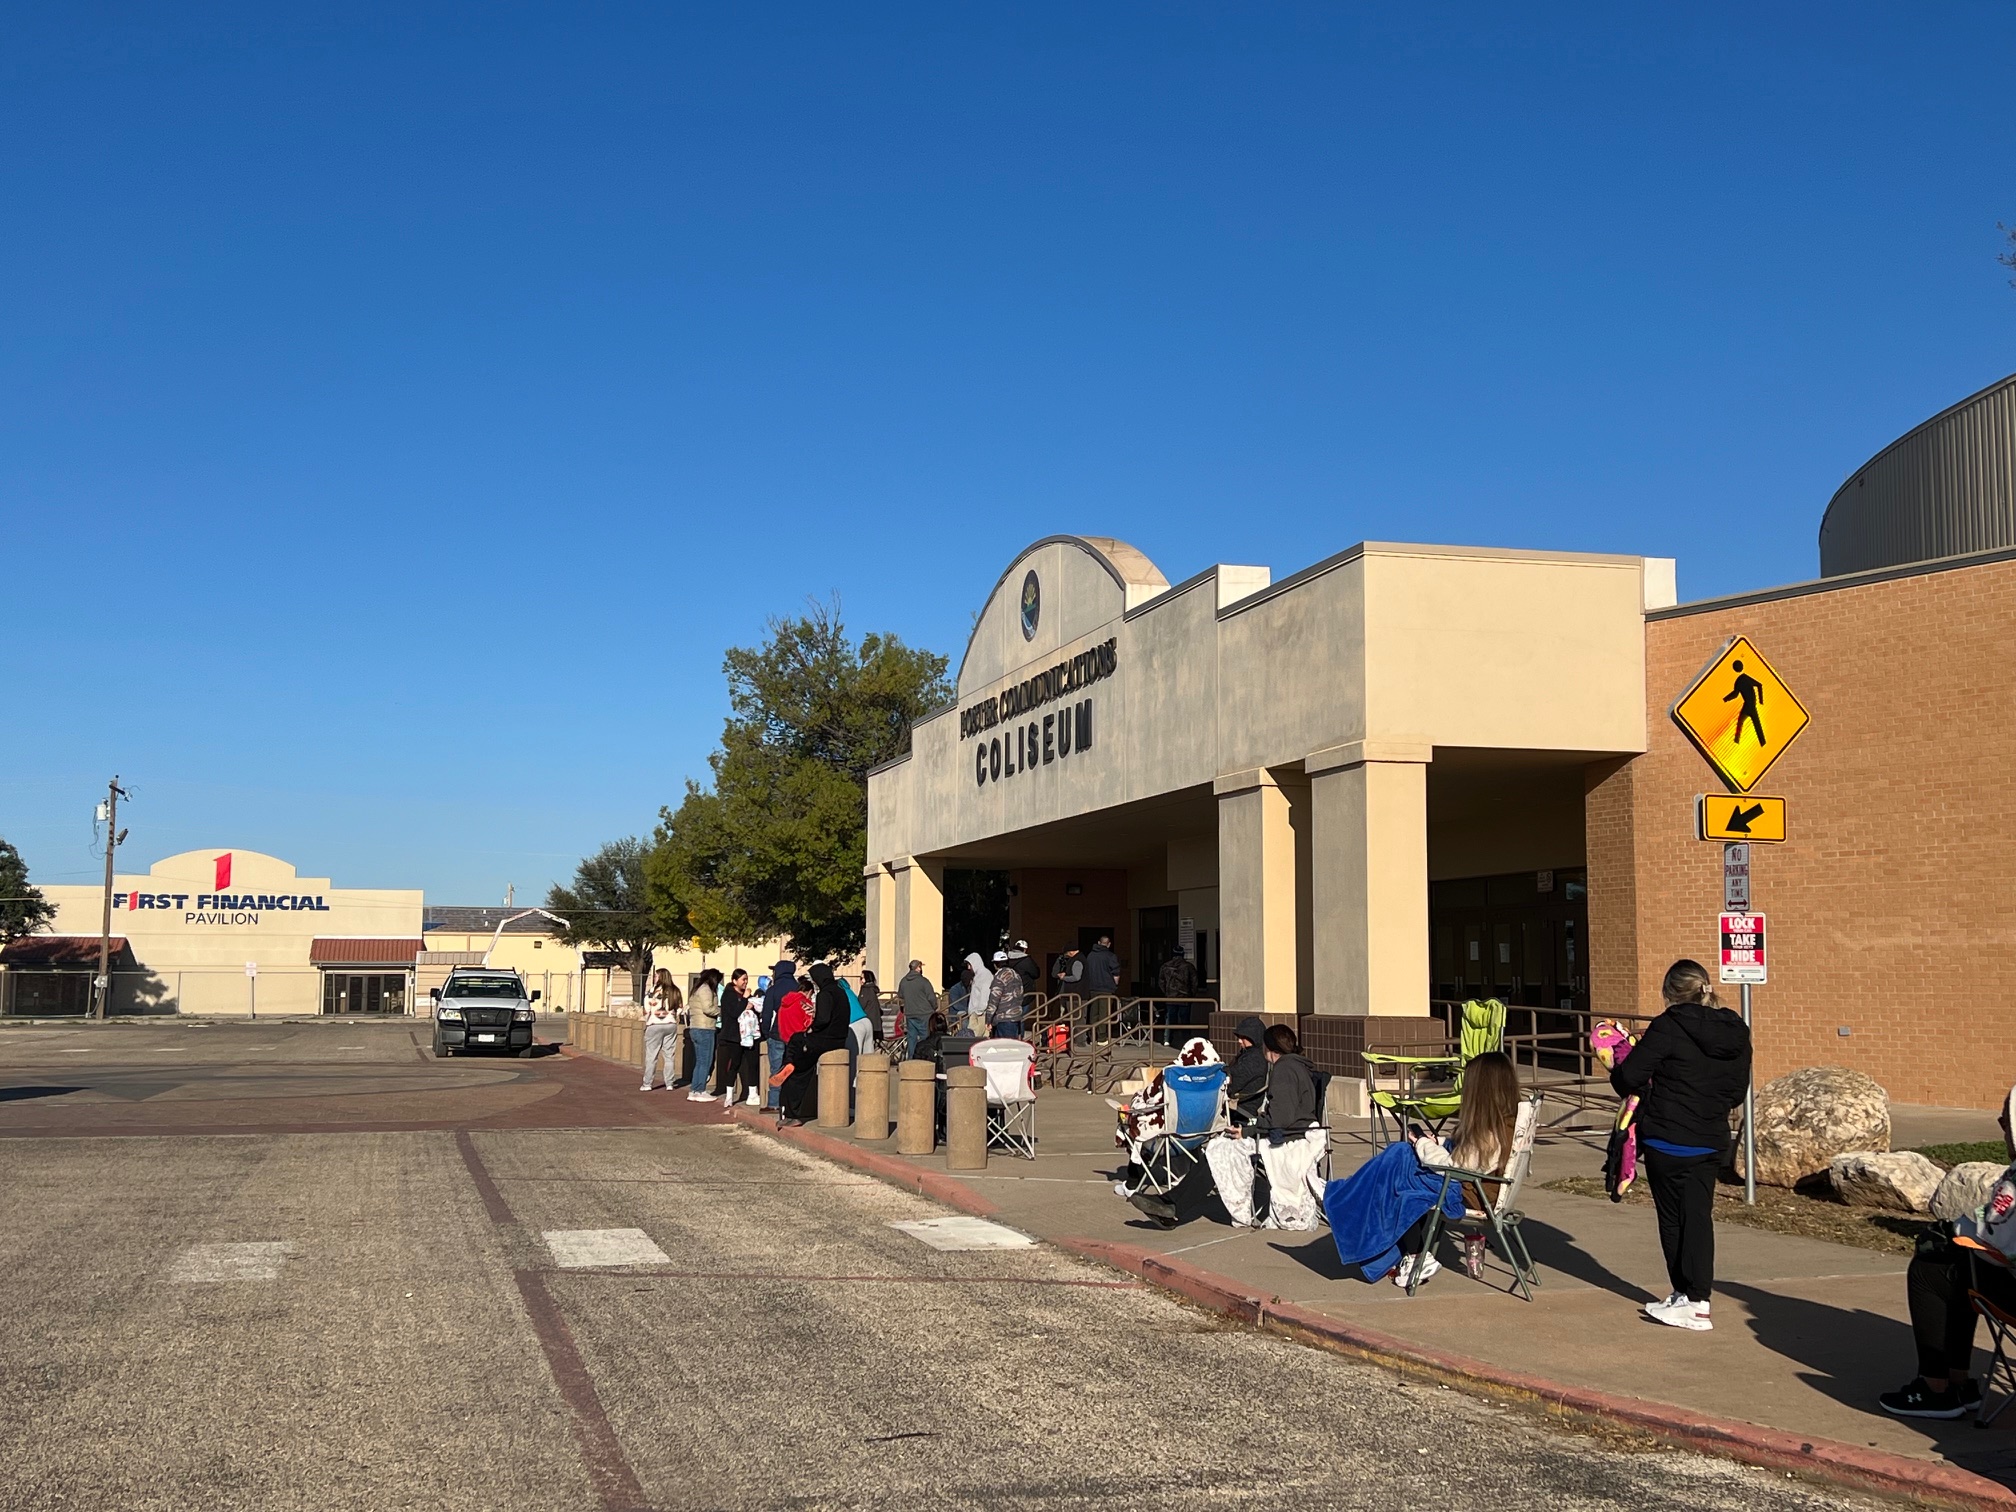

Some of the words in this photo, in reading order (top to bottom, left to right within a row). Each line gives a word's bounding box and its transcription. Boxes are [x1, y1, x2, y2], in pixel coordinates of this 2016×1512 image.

[960, 696, 999, 741] FOSTER
[1000, 637, 1117, 723] COMMUNICATIONS
[976, 698, 1092, 787] COLISEUM
[1731, 847, 1742, 861] NO
[1725, 864, 1748, 877] PARKING
[1732, 879, 1742, 887] ANY
[1731, 889, 1743, 898] TIME
[112, 891, 189, 911] FIRST
[197, 894, 330, 911] FINANCIAL
[185, 912, 259, 925] PAVILION
[1728, 917, 1756, 930] LOCK
[1729, 934, 1756, 946] TAKE
[1730, 950, 1756, 962] HIDE
